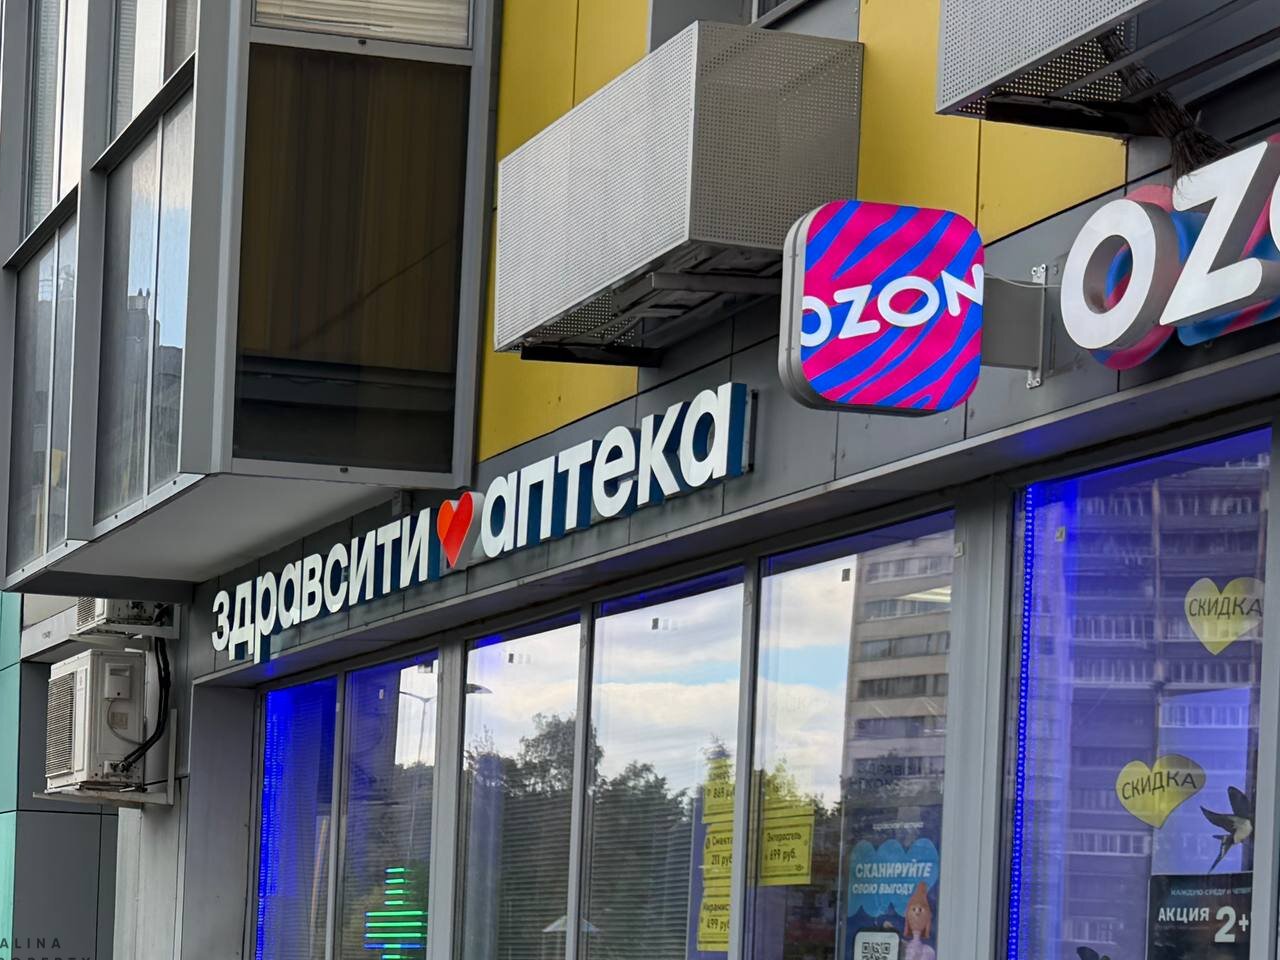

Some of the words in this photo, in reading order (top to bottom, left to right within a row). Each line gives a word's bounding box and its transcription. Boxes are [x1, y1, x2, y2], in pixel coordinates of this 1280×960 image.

[1061, 141, 1280, 350] OZ
[799, 263, 984, 348] OZON
[211, 507, 432, 664] здравсити
[480, 382, 734, 559] аптека
[1188, 596, 1263, 620] СКИДКА
[1121, 770, 1197, 800] СКИДКА
[855, 859, 933, 879] СКАНИРУЙТЕ
[852, 883, 878, 894] СВОЮ
[879, 883, 914, 896] ВЫГОДУ
[1158, 907, 1210, 924] АКЦИЯ
